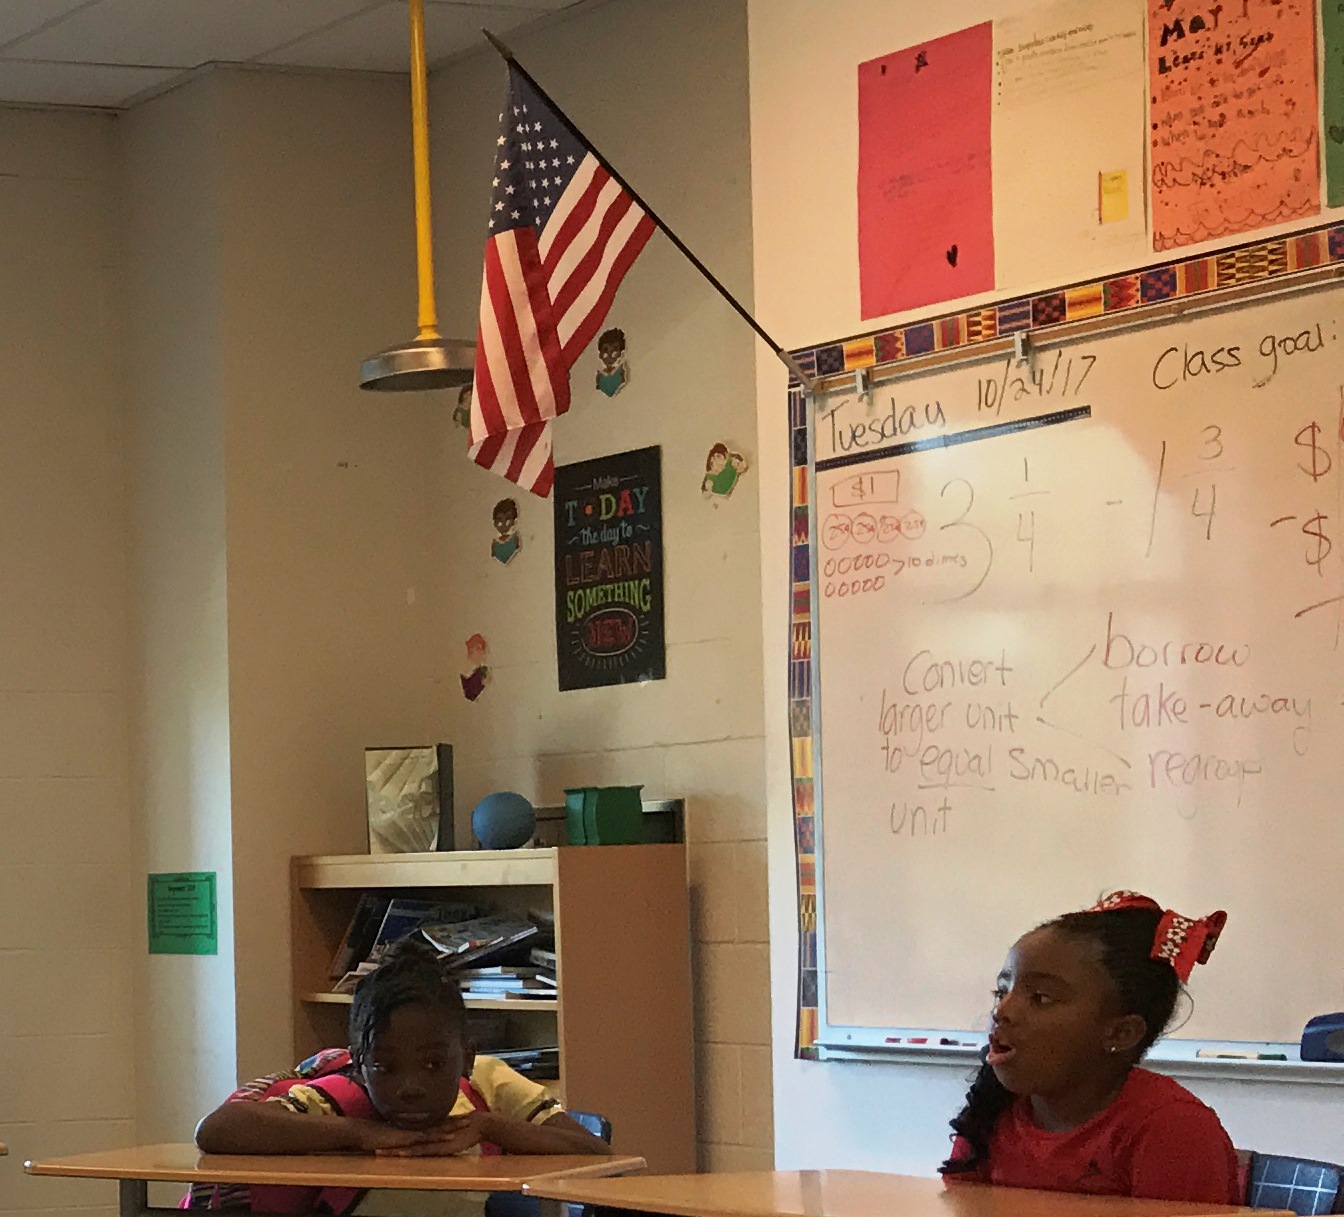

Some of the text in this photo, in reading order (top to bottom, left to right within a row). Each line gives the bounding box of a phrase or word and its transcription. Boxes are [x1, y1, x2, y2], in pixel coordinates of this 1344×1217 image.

[1152, 342, 1241, 390] Class
[821, 349, 1097, 453] Tuesday 10/24/17
[580, 520, 633, 547] the day to
[1191, 483, 1216, 541] 4
[565, 539, 653, 586] LEARN
[566, 578, 653, 623] SOMETHING
[1104, 612, 1251, 669] borrow
[879, 688, 1019, 757] larger unit
[1110, 675, 1312, 757] take-away
[881, 737, 903, 774] to
[919, 743, 993, 787] equal
[890, 797, 952, 837] unit
